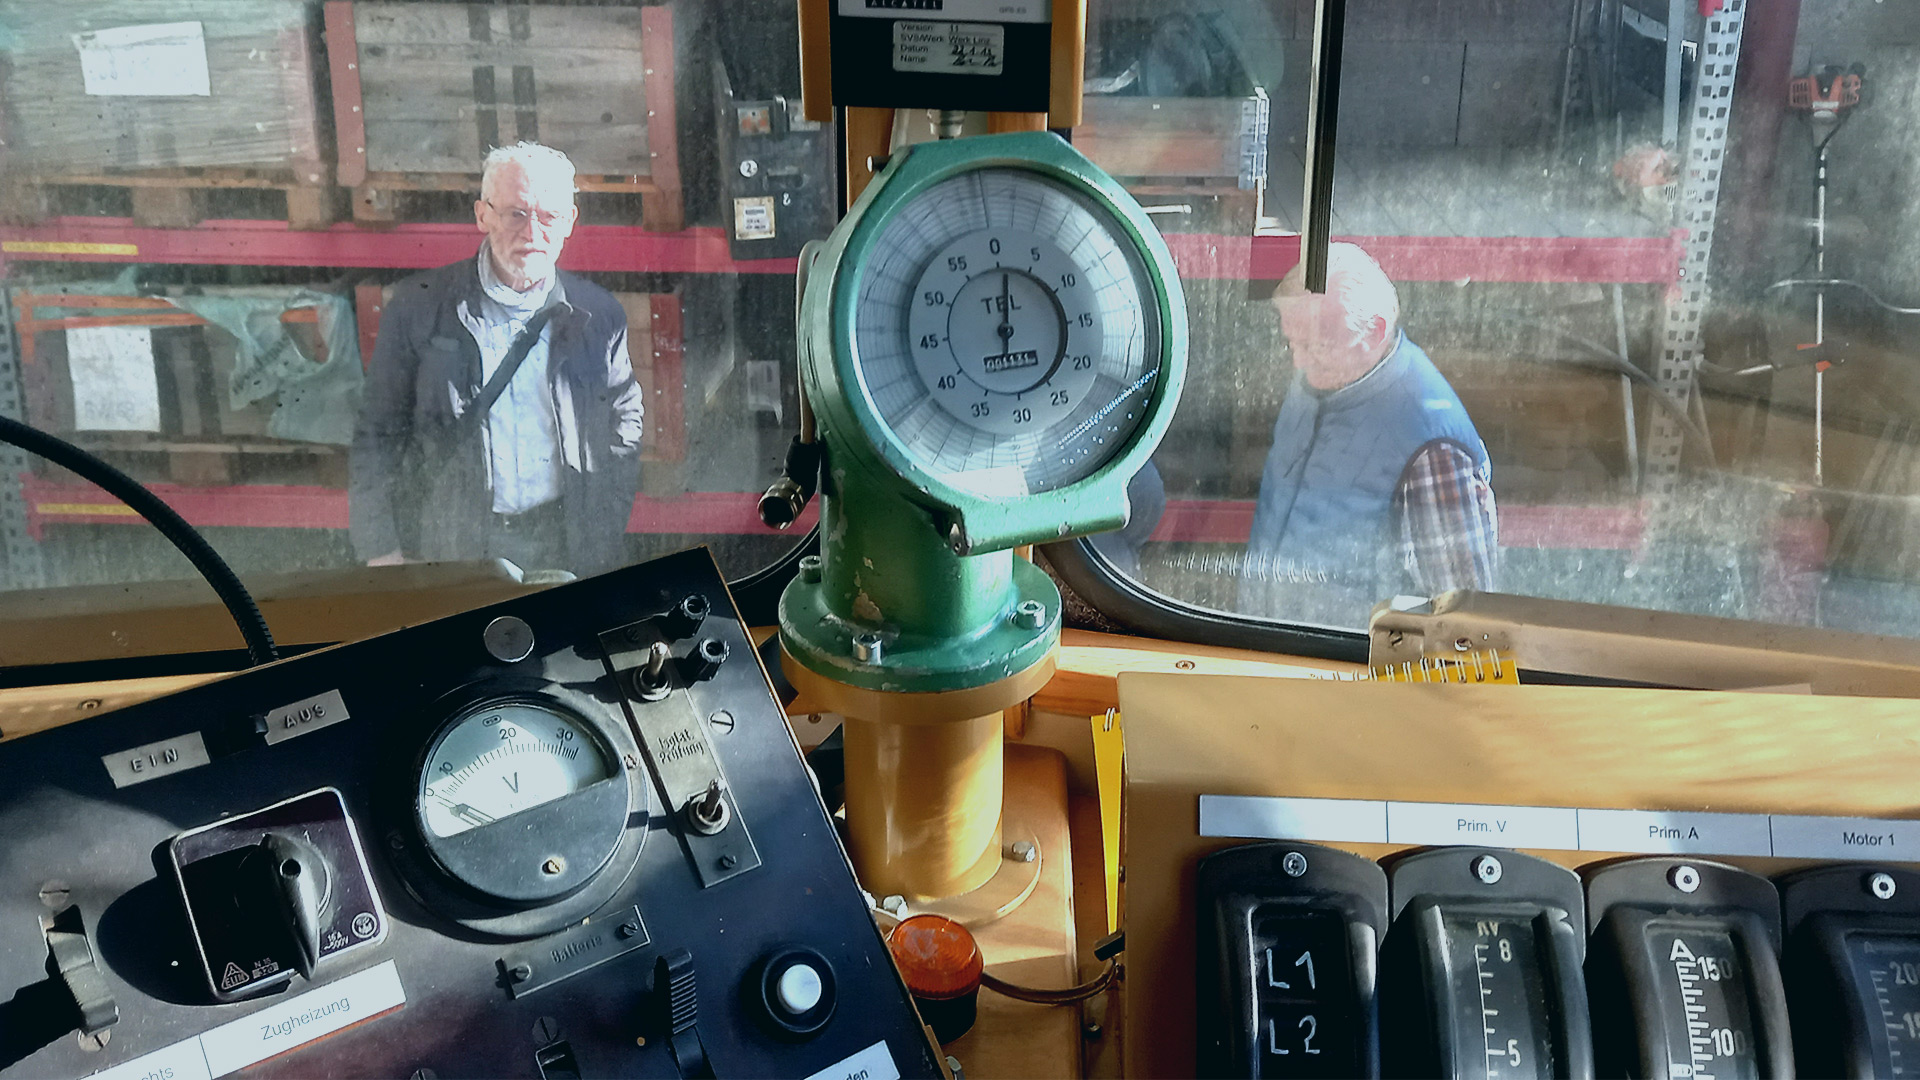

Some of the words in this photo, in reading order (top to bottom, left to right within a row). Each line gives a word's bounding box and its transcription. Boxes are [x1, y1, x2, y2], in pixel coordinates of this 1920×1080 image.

[989, 238, 1001, 255] 0
[1030, 247, 1041, 262] 5
[948, 256, 968, 272] 55
[1061, 273, 1076, 288] 10
[924, 291, 944, 307] 50
[1078, 312, 1093, 328] 15
[920, 334, 939, 350] 45
[1073, 355, 1092, 370] 20
[937, 376, 957, 390] 40
[1050, 390, 1069, 406] 25
[971, 401, 990, 418] 35
[1012, 408, 1032, 424] 30
[284, 703, 327, 729] AUS
[499, 727, 518, 741] 20
[556, 726, 574, 742] 30
[131, 748, 179, 773] EIN
[438, 760, 455, 776] 10
[502, 771, 519, 794] V
[1457, 818, 1493, 834] Prim.
[1496, 819, 1507, 833] V
[1649, 825, 1685, 841] Prim.
[1687, 826, 1700, 841] A
[1842, 831, 1884, 847] Motor
[1887, 832, 1895, 847] 1
[550, 934, 604, 963] Batterie
[1498, 938, 1513, 963] 8
[1668, 937, 1697, 963] A
[261, 997, 351, 1041] Zugheizung
[1506, 1038, 1522, 1068] 5
